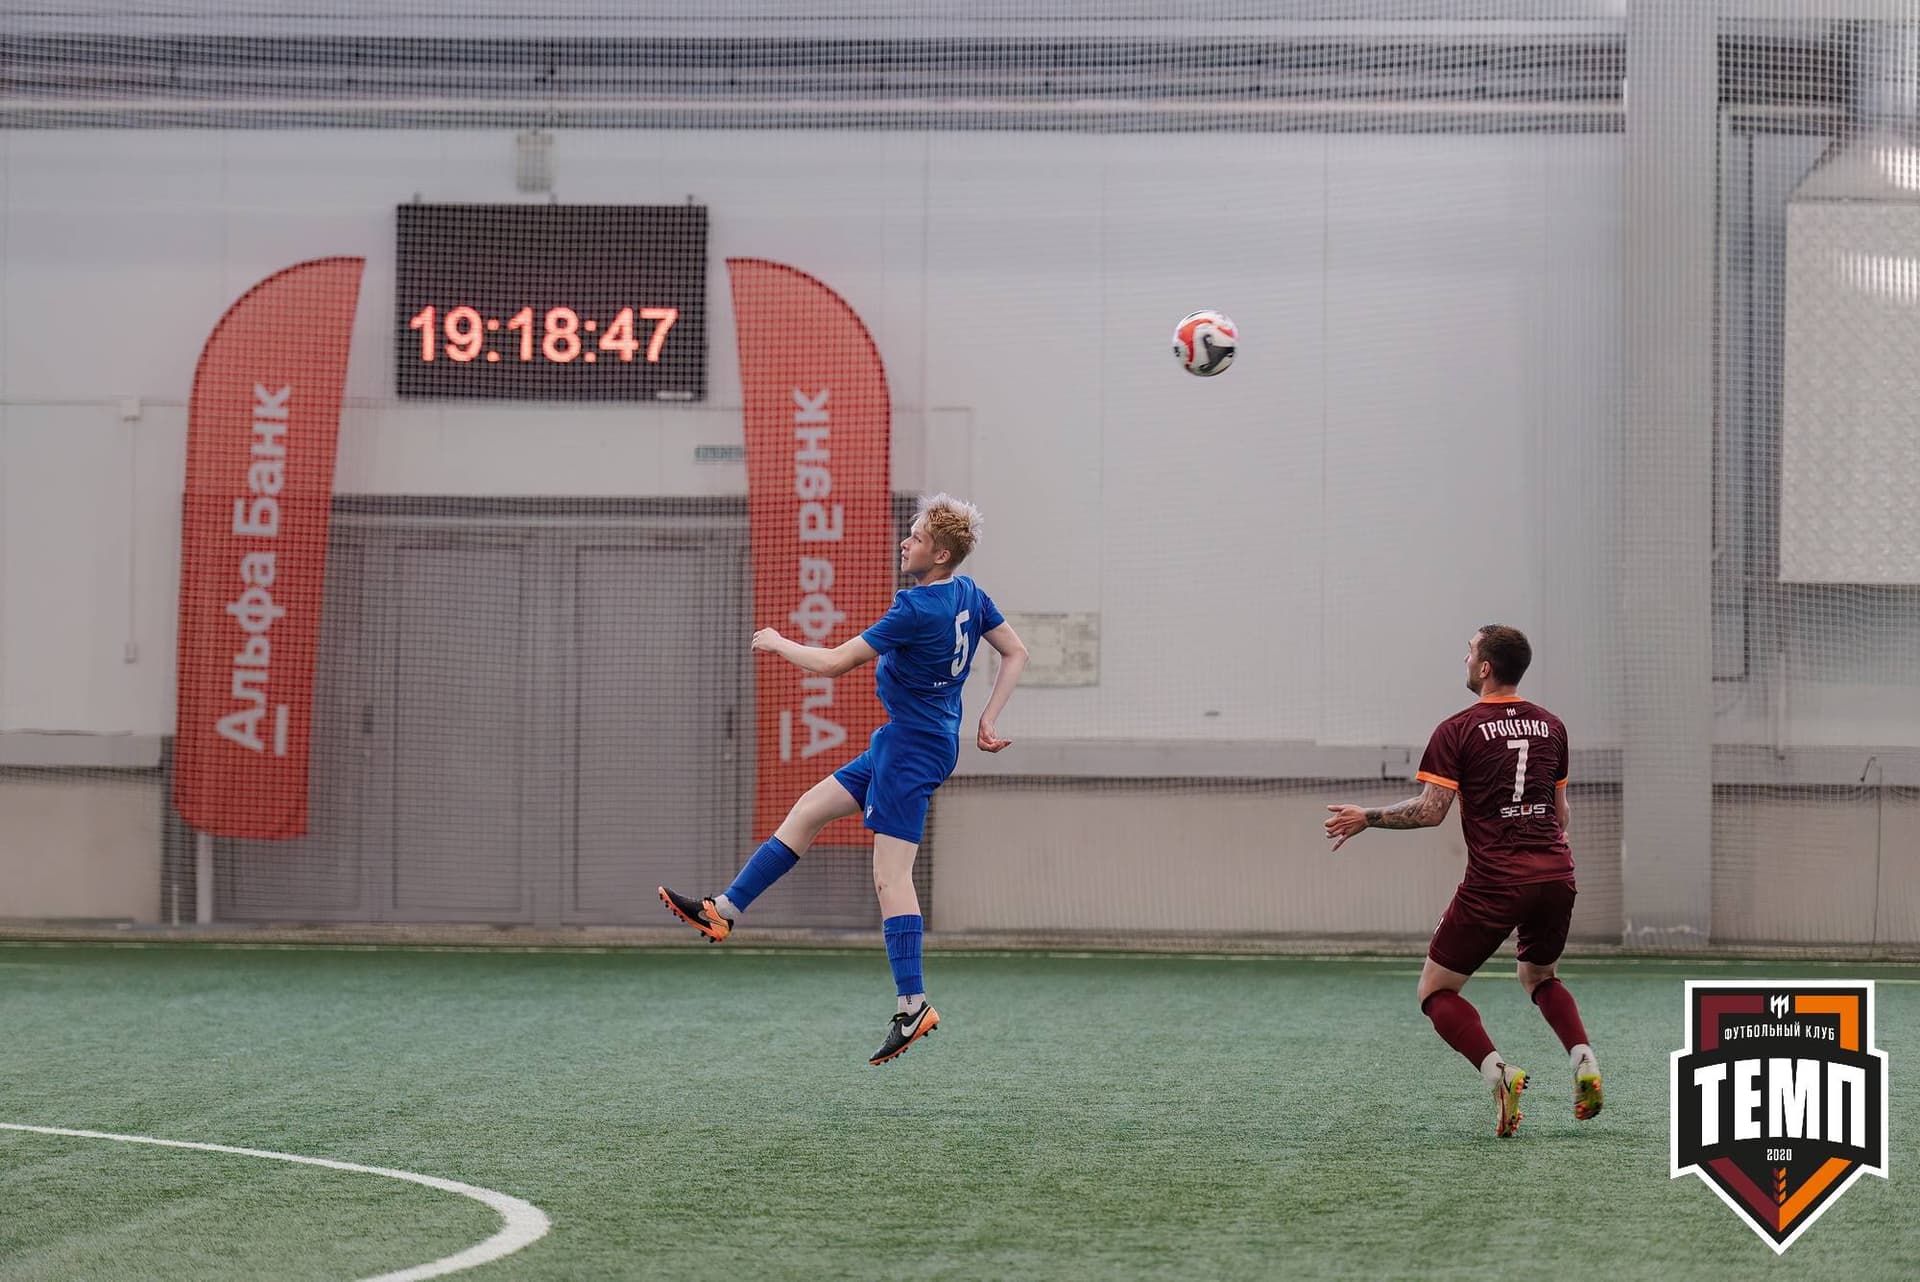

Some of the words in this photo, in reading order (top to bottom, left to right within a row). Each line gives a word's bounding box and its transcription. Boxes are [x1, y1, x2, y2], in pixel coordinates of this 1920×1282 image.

[409, 305, 679, 363] 19:18:47
[232, 382, 291, 537] Банк
[215, 551, 287, 753] Альфа
[951, 609, 970, 677] 5
[1478, 719, 1549, 740] ТРОЦЕНКО
[1507, 739, 1529, 802] 7
